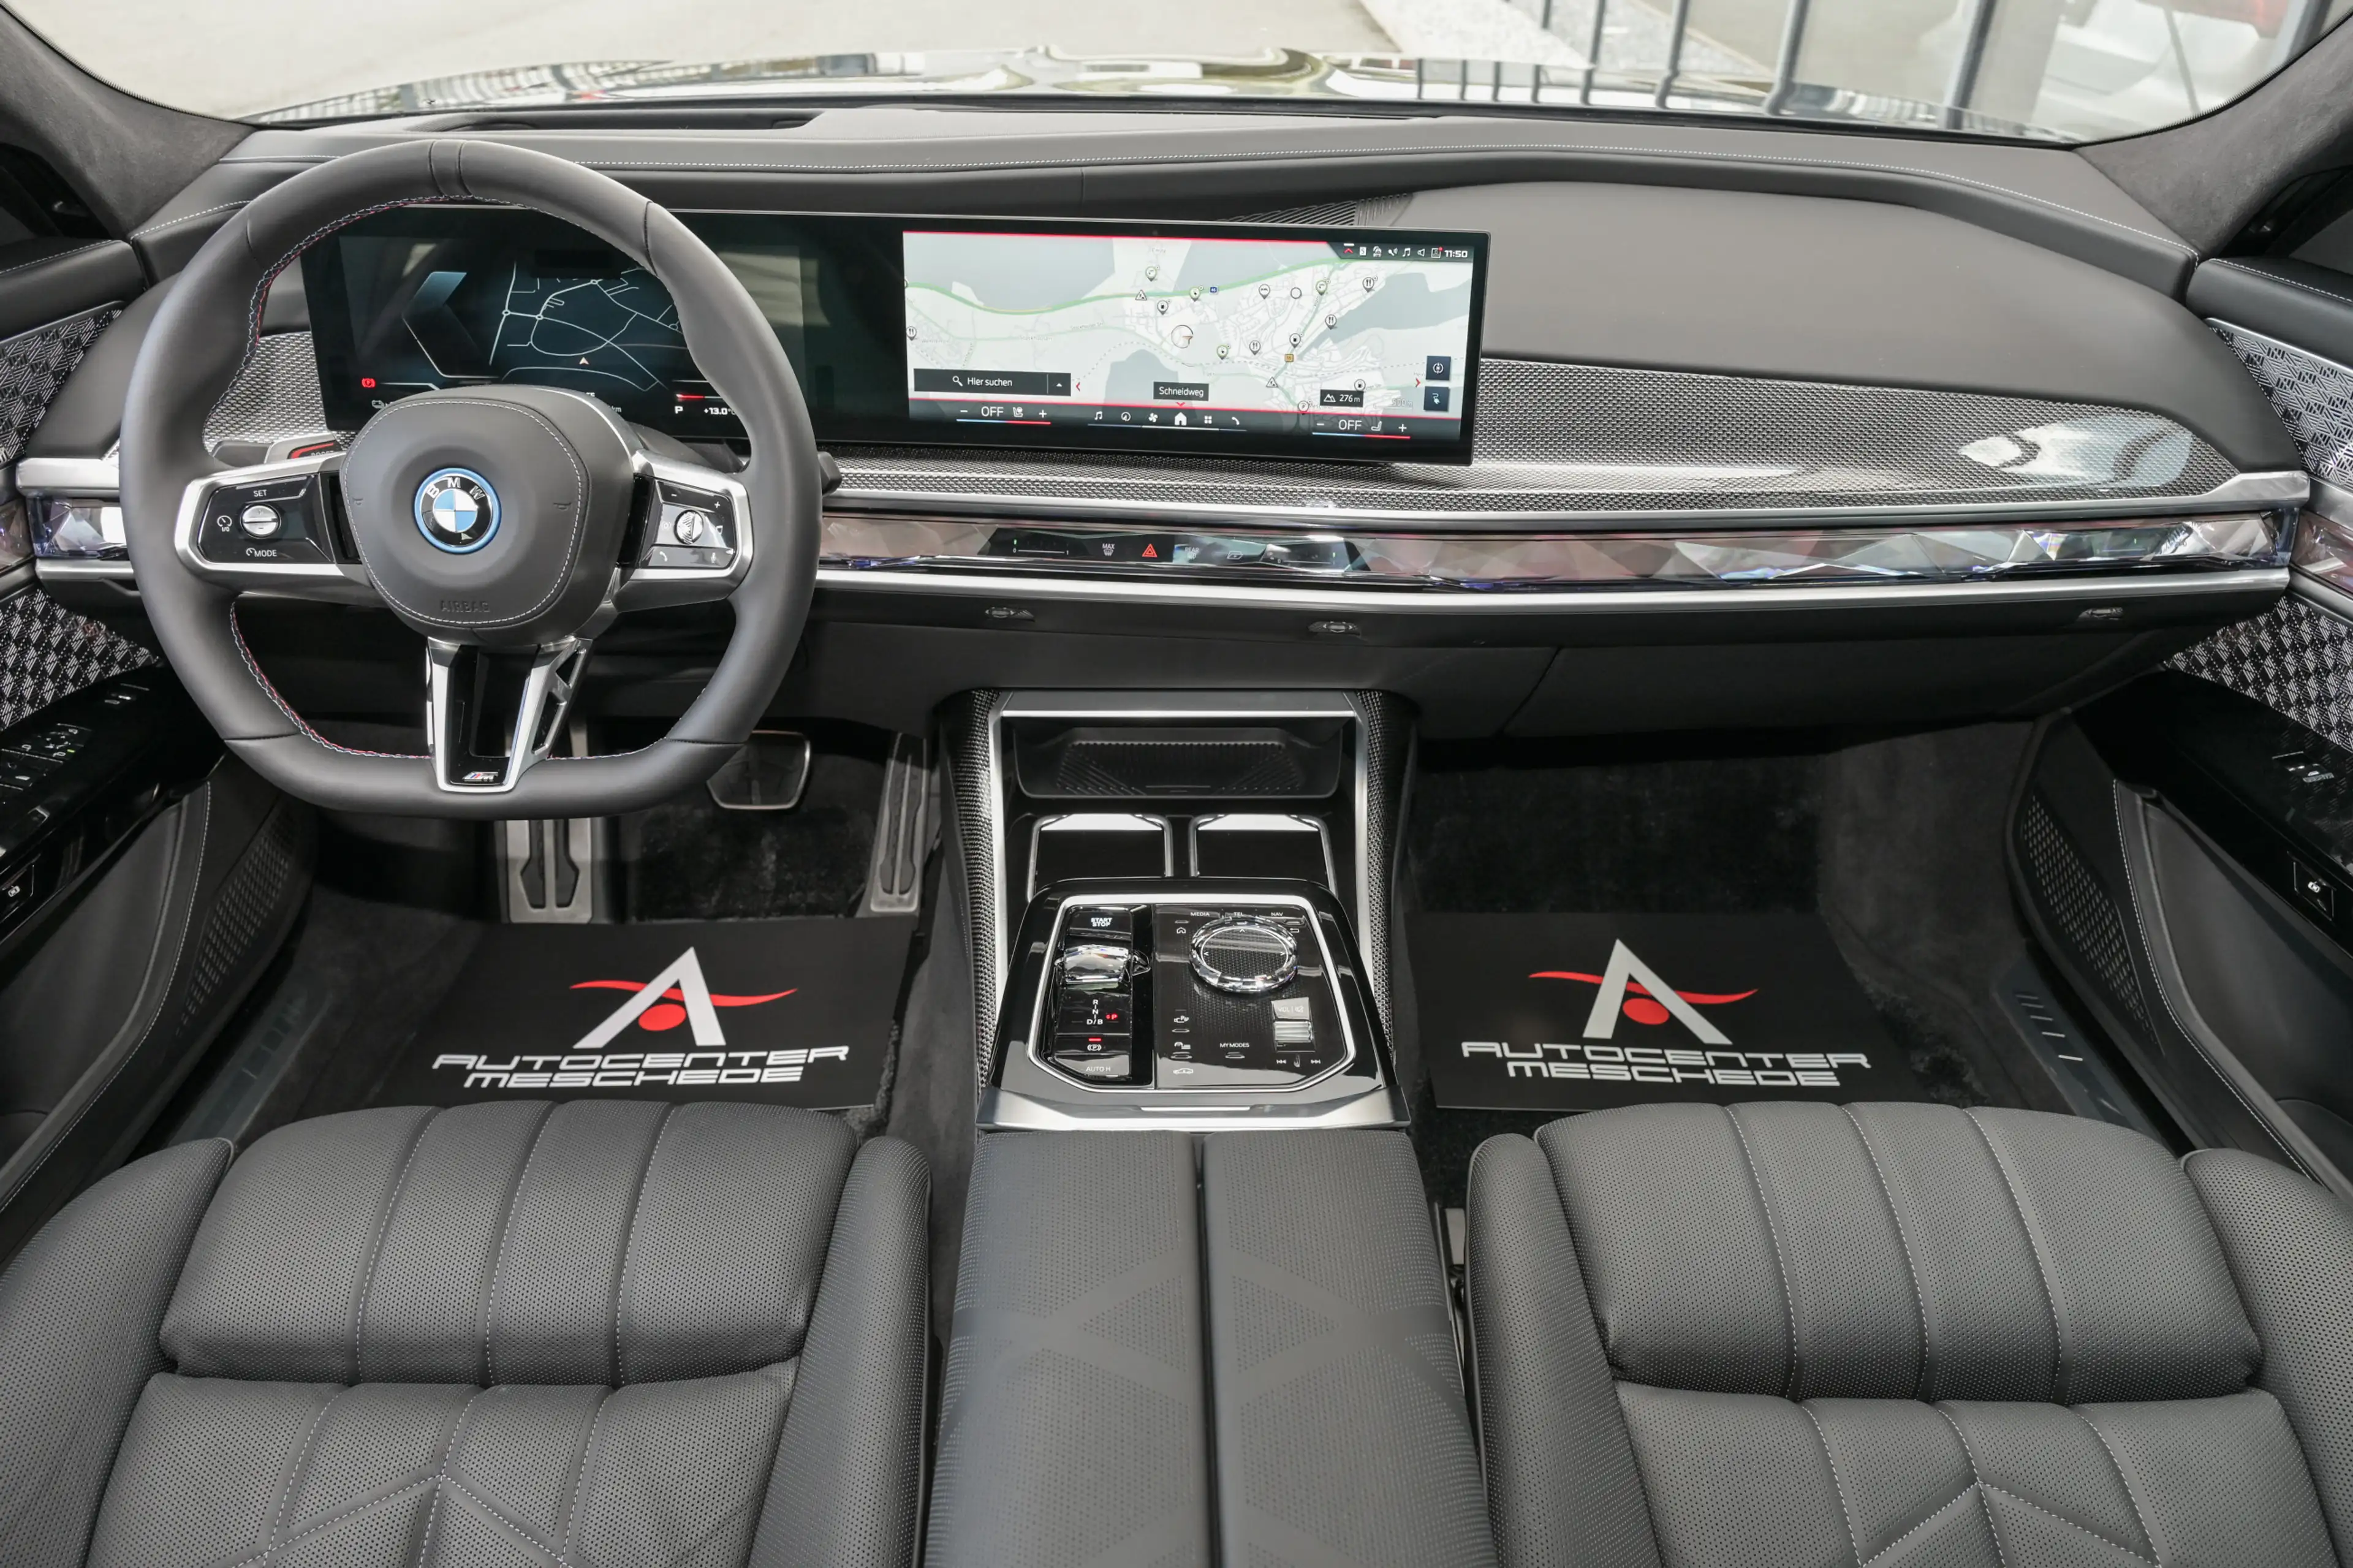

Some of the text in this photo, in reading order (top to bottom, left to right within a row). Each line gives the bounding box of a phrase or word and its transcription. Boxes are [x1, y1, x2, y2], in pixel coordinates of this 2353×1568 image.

[1444, 249, 1468, 258] 11:50
[967, 377, 983, 386] Hier
[1159, 386, 1204, 398] Schneidweg
[1339, 393, 1353, 402] 276
[981, 406, 1004, 417] OFF
[1338, 419, 1362, 431] OFF
[426, 477, 485, 499] BMW
[441, 600, 490, 613] AIRBAG
[432, 1046, 849, 1070] AUTOCENTER
[1461, 1042, 1871, 1069] AUTOCENTER
[464, 1066, 803, 1089] MESCHEDE
[1507, 1061, 1841, 1086] MESCHEDE
